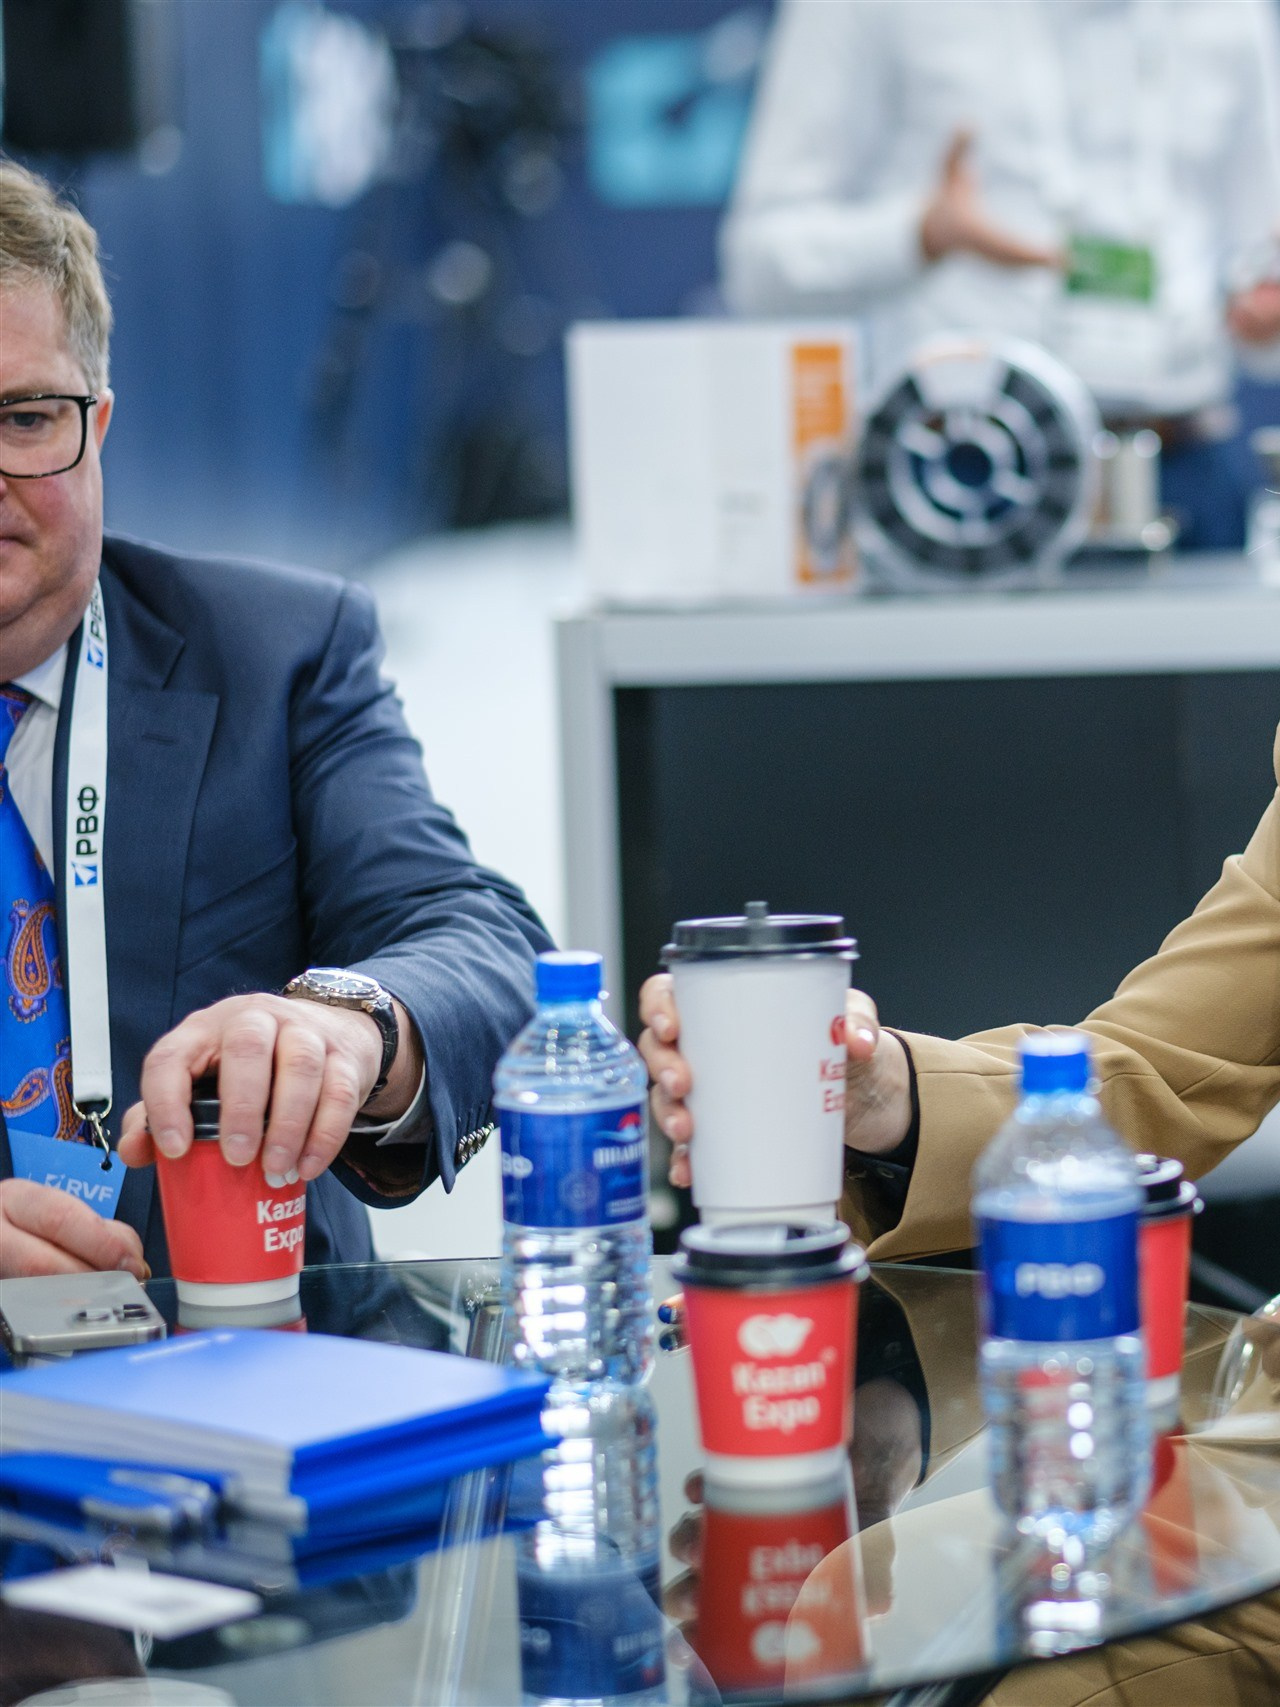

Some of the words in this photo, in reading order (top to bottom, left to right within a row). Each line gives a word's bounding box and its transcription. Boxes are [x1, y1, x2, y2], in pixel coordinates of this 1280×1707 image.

[76, 786, 100, 856] РВФ
[732, 1361, 827, 1396] Kazan
[742, 1395, 821, 1435] Expo
